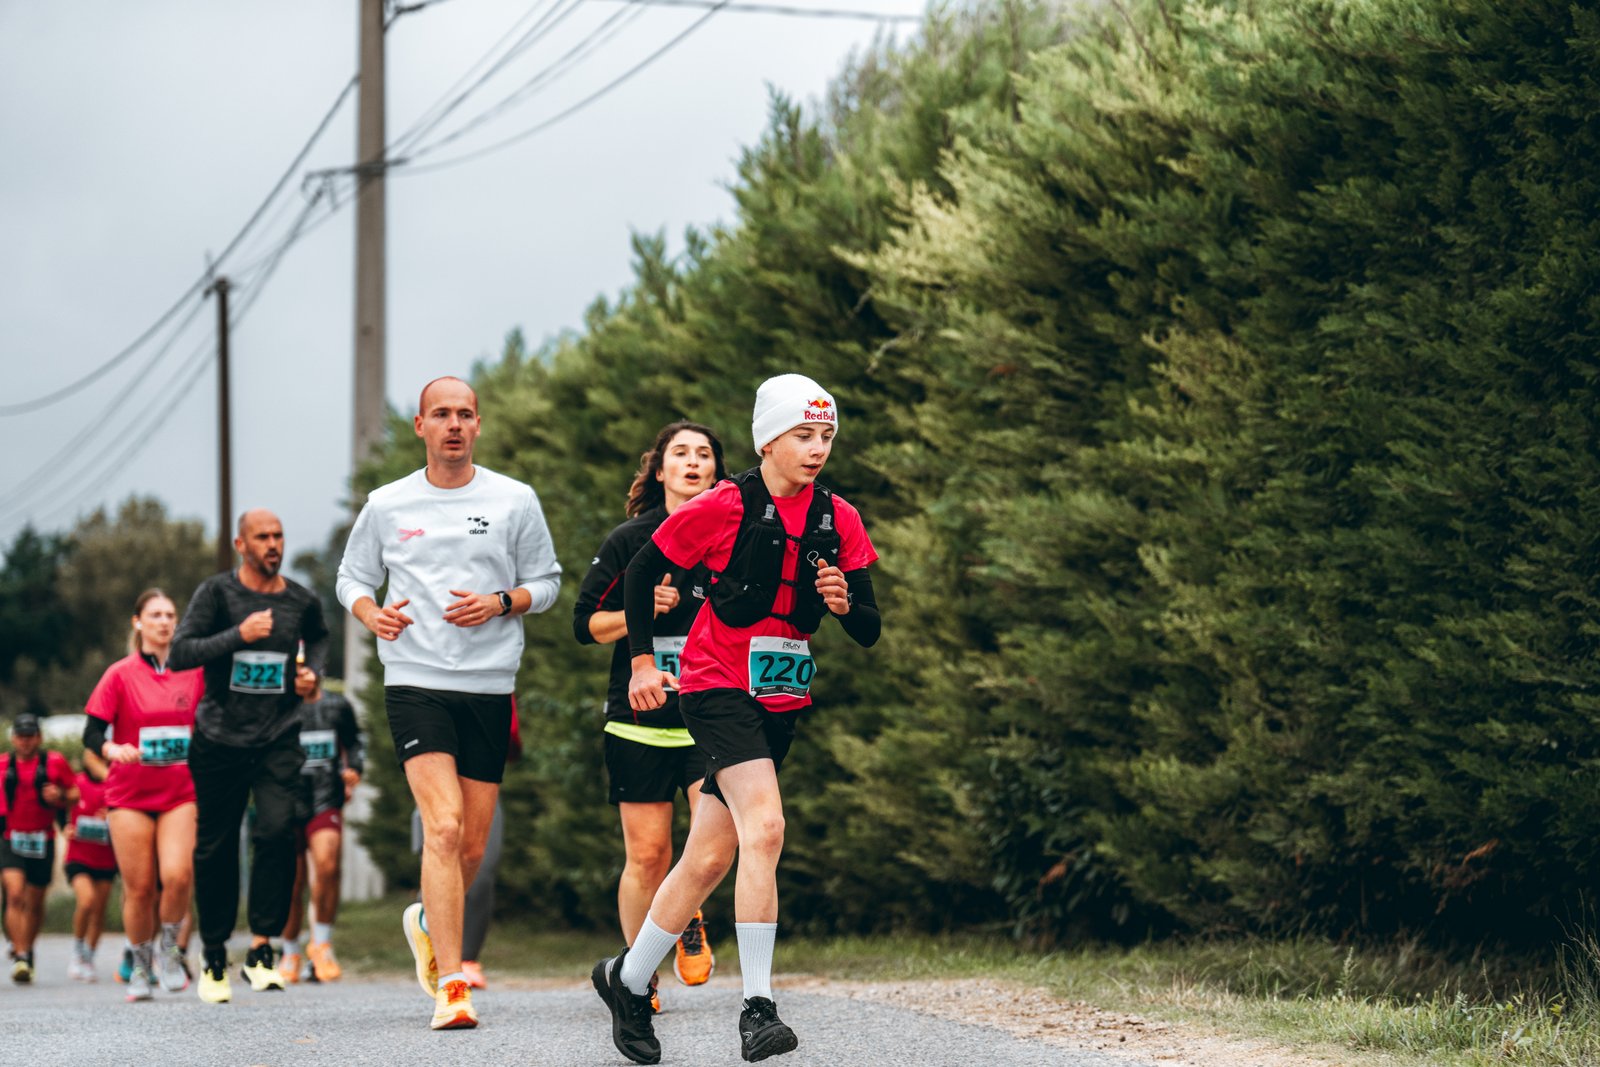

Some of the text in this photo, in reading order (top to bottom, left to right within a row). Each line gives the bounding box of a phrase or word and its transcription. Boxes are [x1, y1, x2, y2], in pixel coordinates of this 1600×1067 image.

[804, 410, 822, 420] Red
[239, 663, 278, 683] 322
[758, 654, 813, 685] 220
